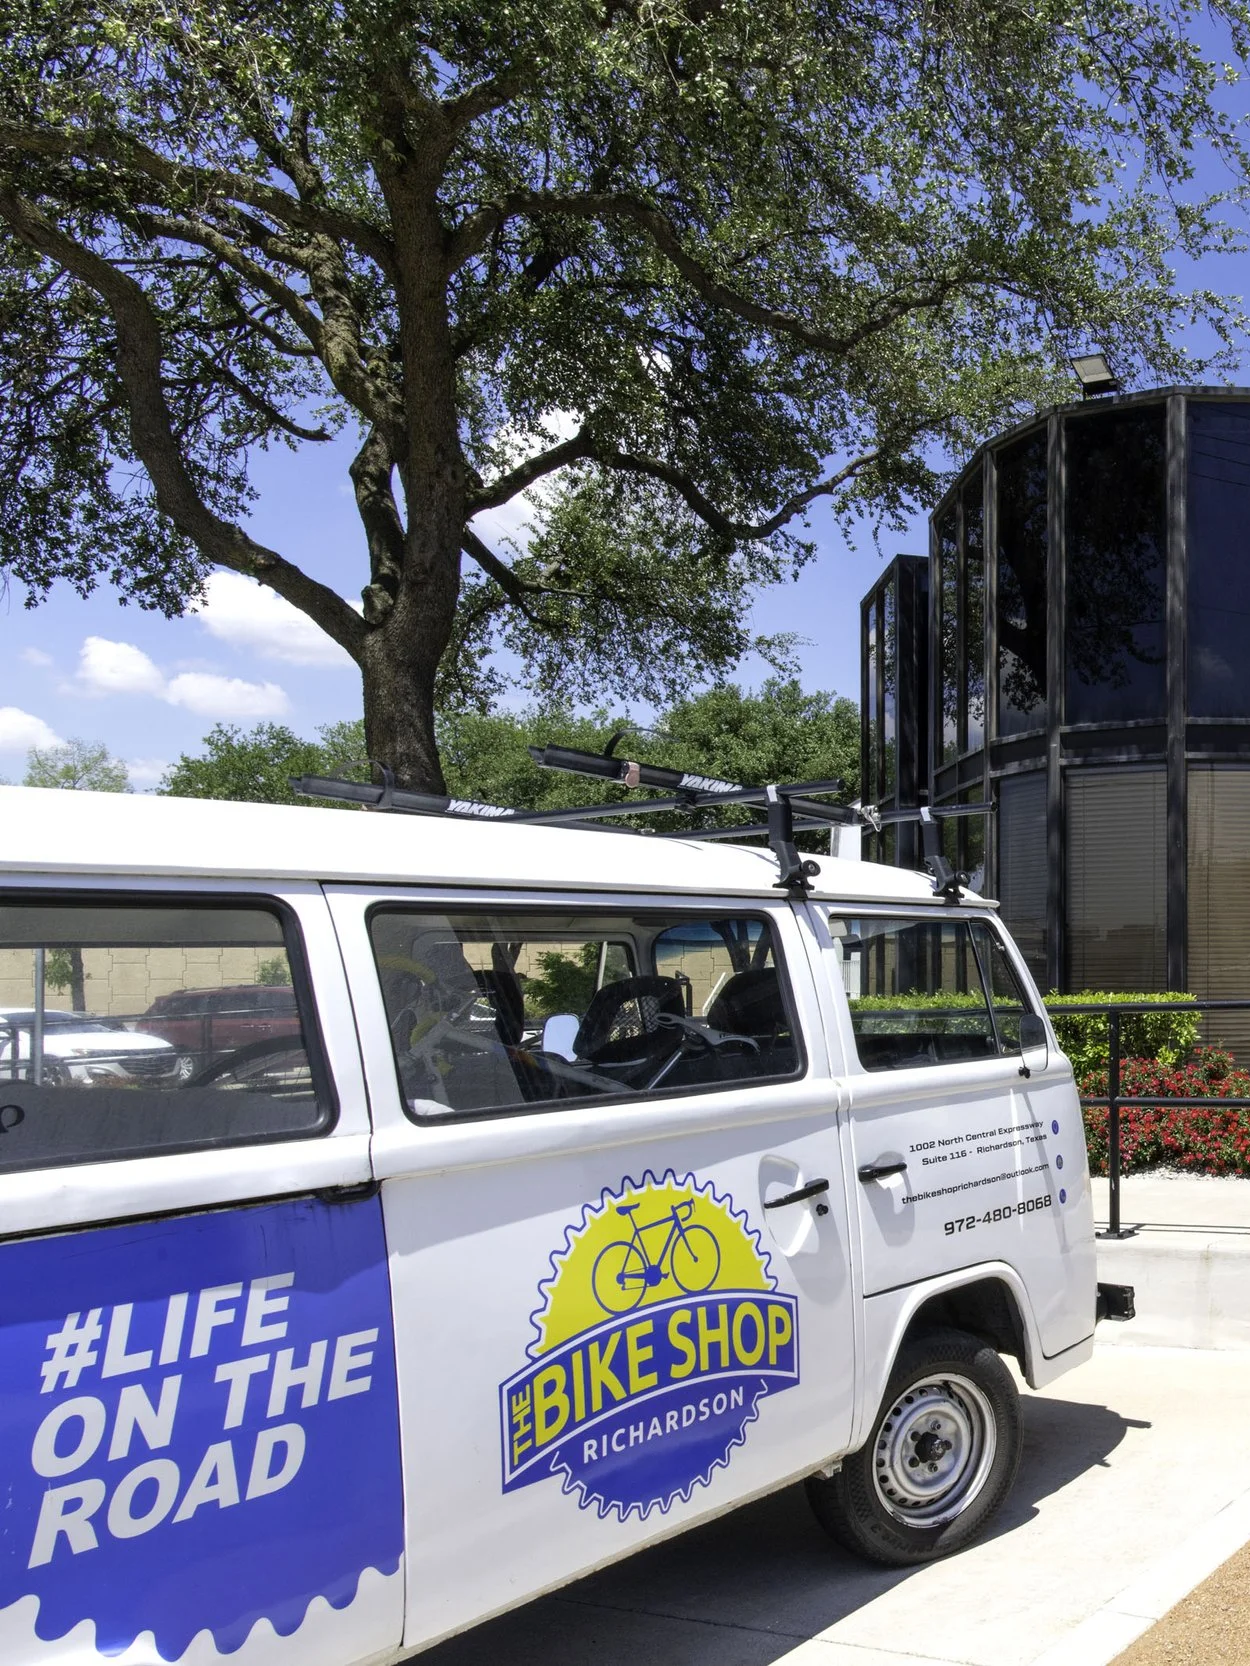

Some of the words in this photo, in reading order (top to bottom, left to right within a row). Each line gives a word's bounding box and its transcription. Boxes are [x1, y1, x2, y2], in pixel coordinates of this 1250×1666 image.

[909, 1141, 936, 1153] 1002
[937, 1136, 964, 1148] North
[965, 1129, 997, 1142] Central
[998, 1120, 1044, 1136] Expressway
[922, 1153, 947, 1166] Suite
[949, 1149, 967, 1161] 116
[976, 1139, 1024, 1155] Richardson,
[1025, 1133, 1048, 1144] Texas
[902, 1162, 1050, 1205] thebikeshoprichardson@outlook.com
[944, 1194, 1052, 1236] 972-480-8068
[39, 1271, 295, 1395] #LIFE
[30, 1374, 182, 1478] ON
[214, 1327, 380, 1431] THE
[511, 1383, 530, 1467] THE
[532, 1319, 658, 1449] BIKE
[667, 1301, 793, 1379] SHOP
[583, 1386, 744, 1465] RICHARDSON
[27, 1422, 307, 1570] ROAD
